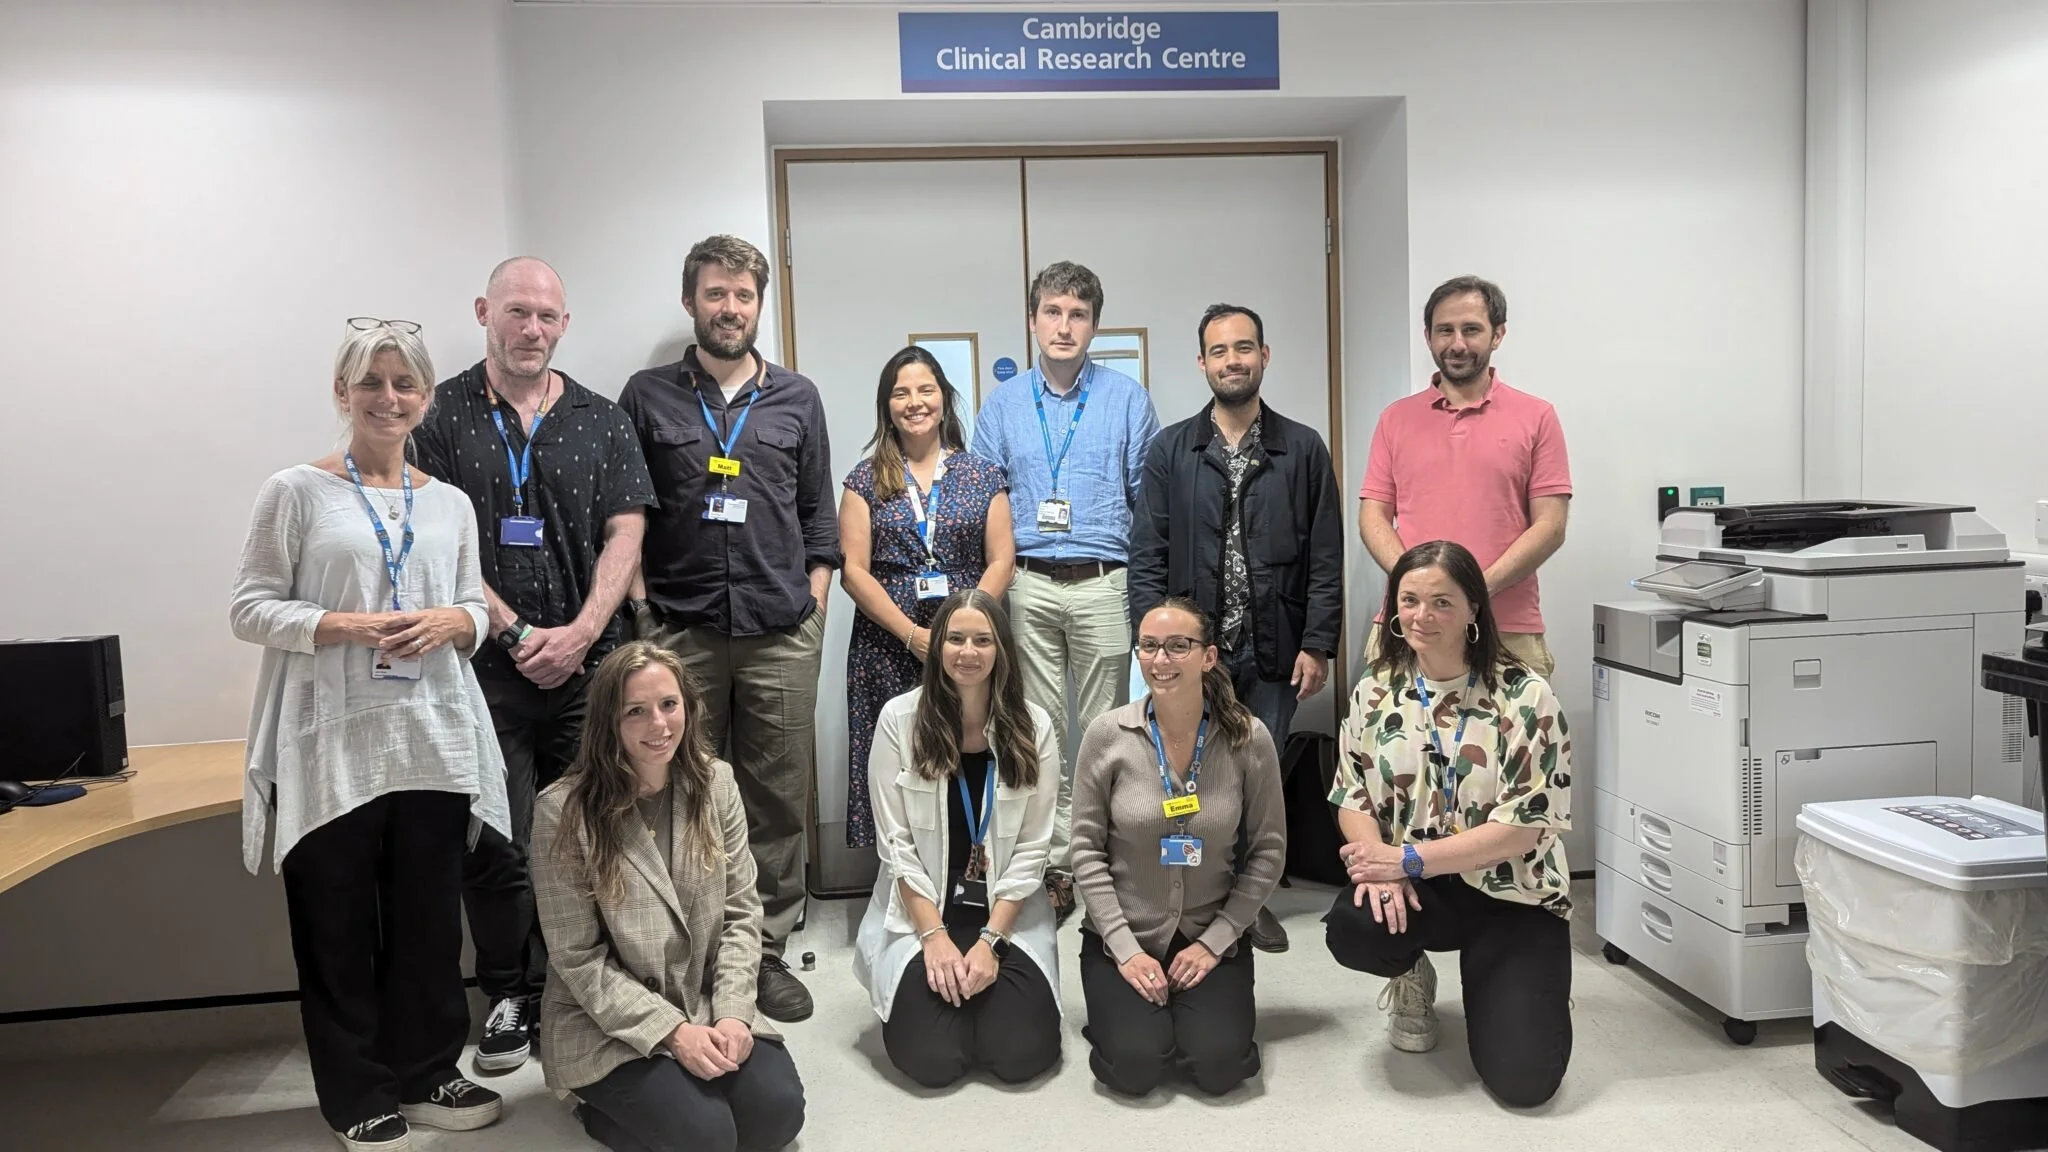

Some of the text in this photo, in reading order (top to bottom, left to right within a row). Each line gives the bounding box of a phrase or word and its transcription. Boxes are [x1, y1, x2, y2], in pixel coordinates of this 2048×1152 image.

[1022, 16, 1161, 44] Cambridge
[936, 46, 1247, 70] Clinical Research Centre
[385, 548, 393, 563] NHS
[1170, 803, 1193, 812] Emma
